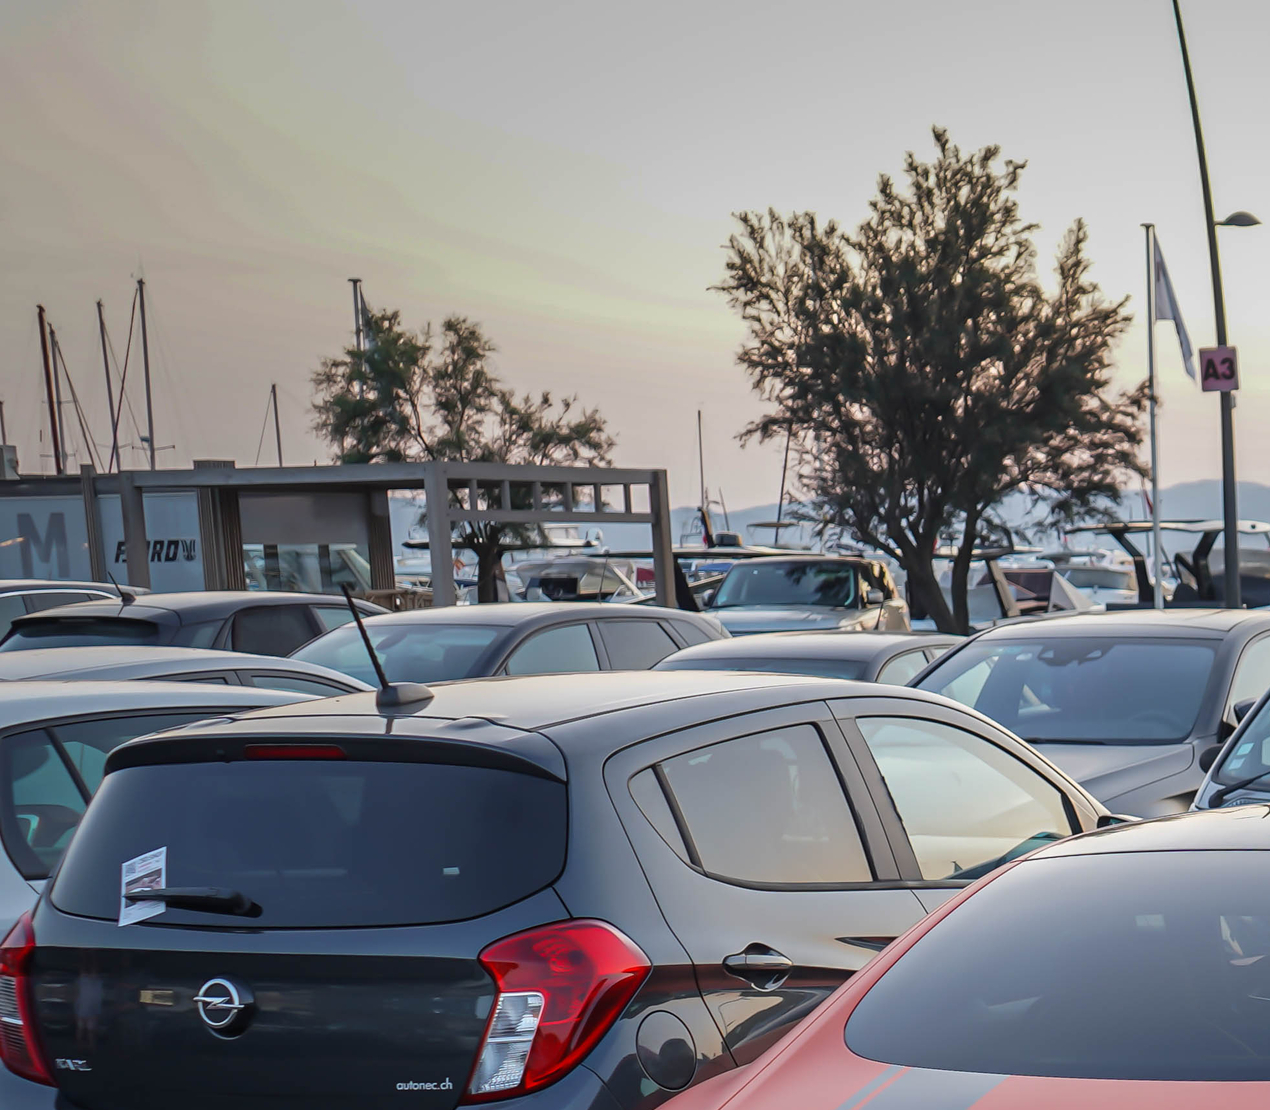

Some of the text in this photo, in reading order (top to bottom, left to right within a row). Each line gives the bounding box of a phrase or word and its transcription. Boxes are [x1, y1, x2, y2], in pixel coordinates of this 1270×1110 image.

[1204, 357, 1235, 380] A3
[115, 540, 179, 563] FRD
[396, 1077, 453, 1090] autonec.ch
